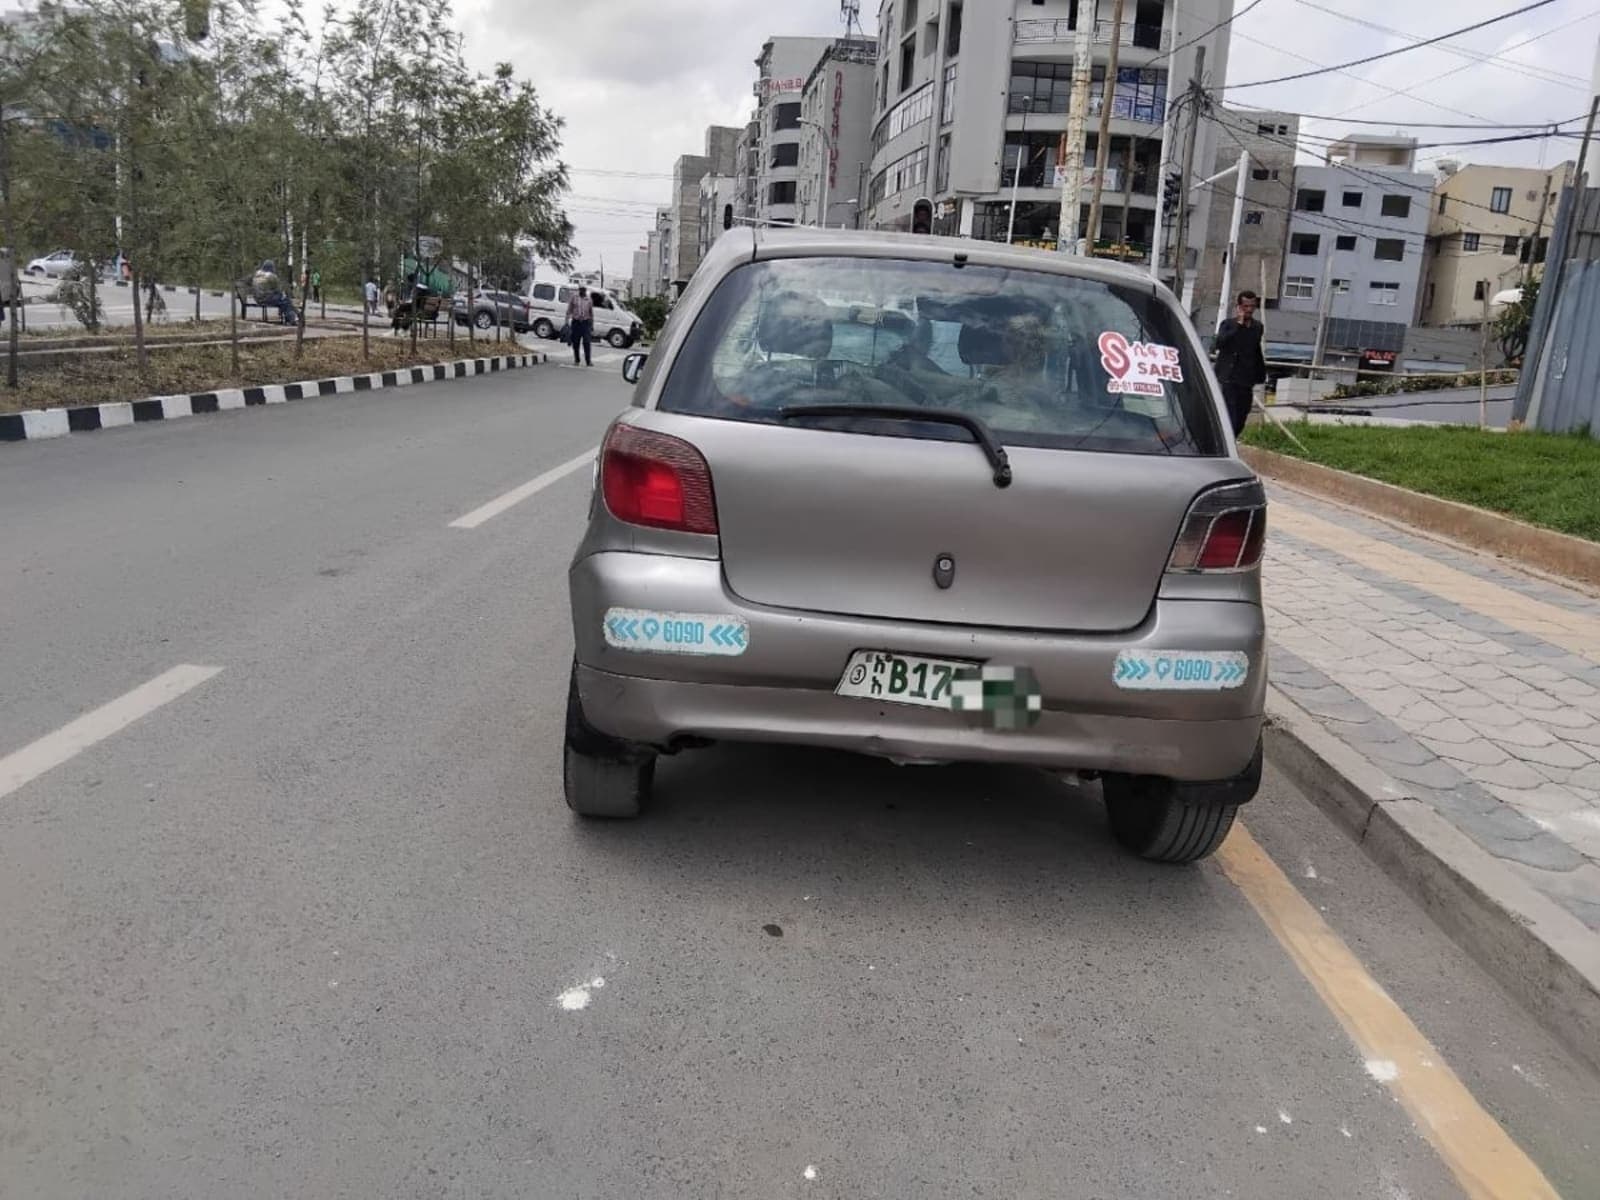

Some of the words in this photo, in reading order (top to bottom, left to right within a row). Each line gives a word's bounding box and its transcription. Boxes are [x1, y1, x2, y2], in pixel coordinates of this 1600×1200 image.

[1163, 348, 1177, 361] IS
[1137, 362, 1181, 380] SAFE
[663, 619, 705, 644] 6090
[888, 657, 954, 701] B17
[1174, 658, 1212, 681] 6090
